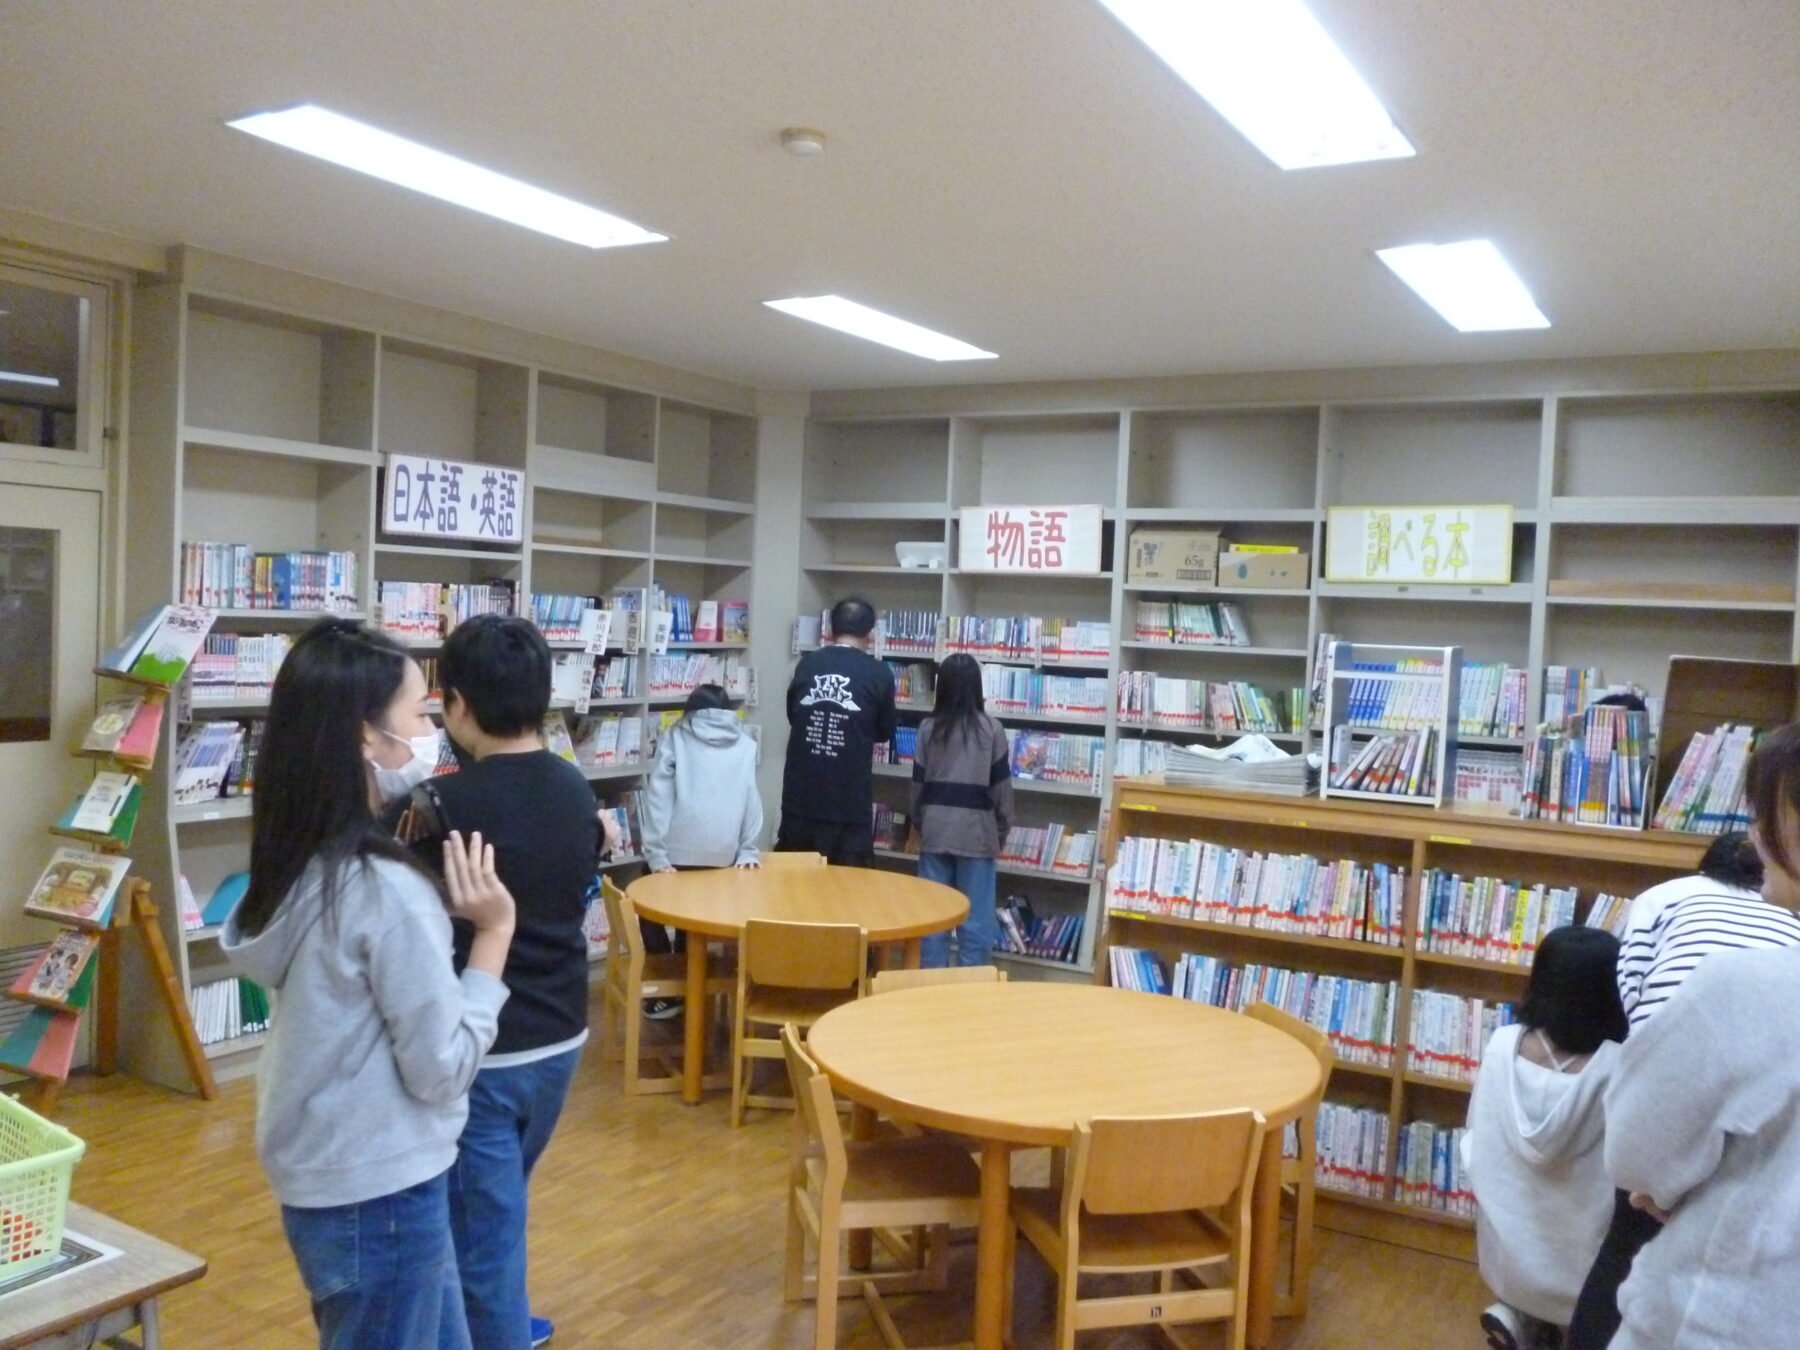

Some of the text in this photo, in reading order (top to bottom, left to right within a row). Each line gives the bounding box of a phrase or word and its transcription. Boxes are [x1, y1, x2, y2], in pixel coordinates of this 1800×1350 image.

[393, 460, 518, 538] 日本語・英語
[987, 510, 1068, 569] 物語
[1184, 555, 1205, 569] 65g
[1366, 511, 1471, 578] 調べる本
